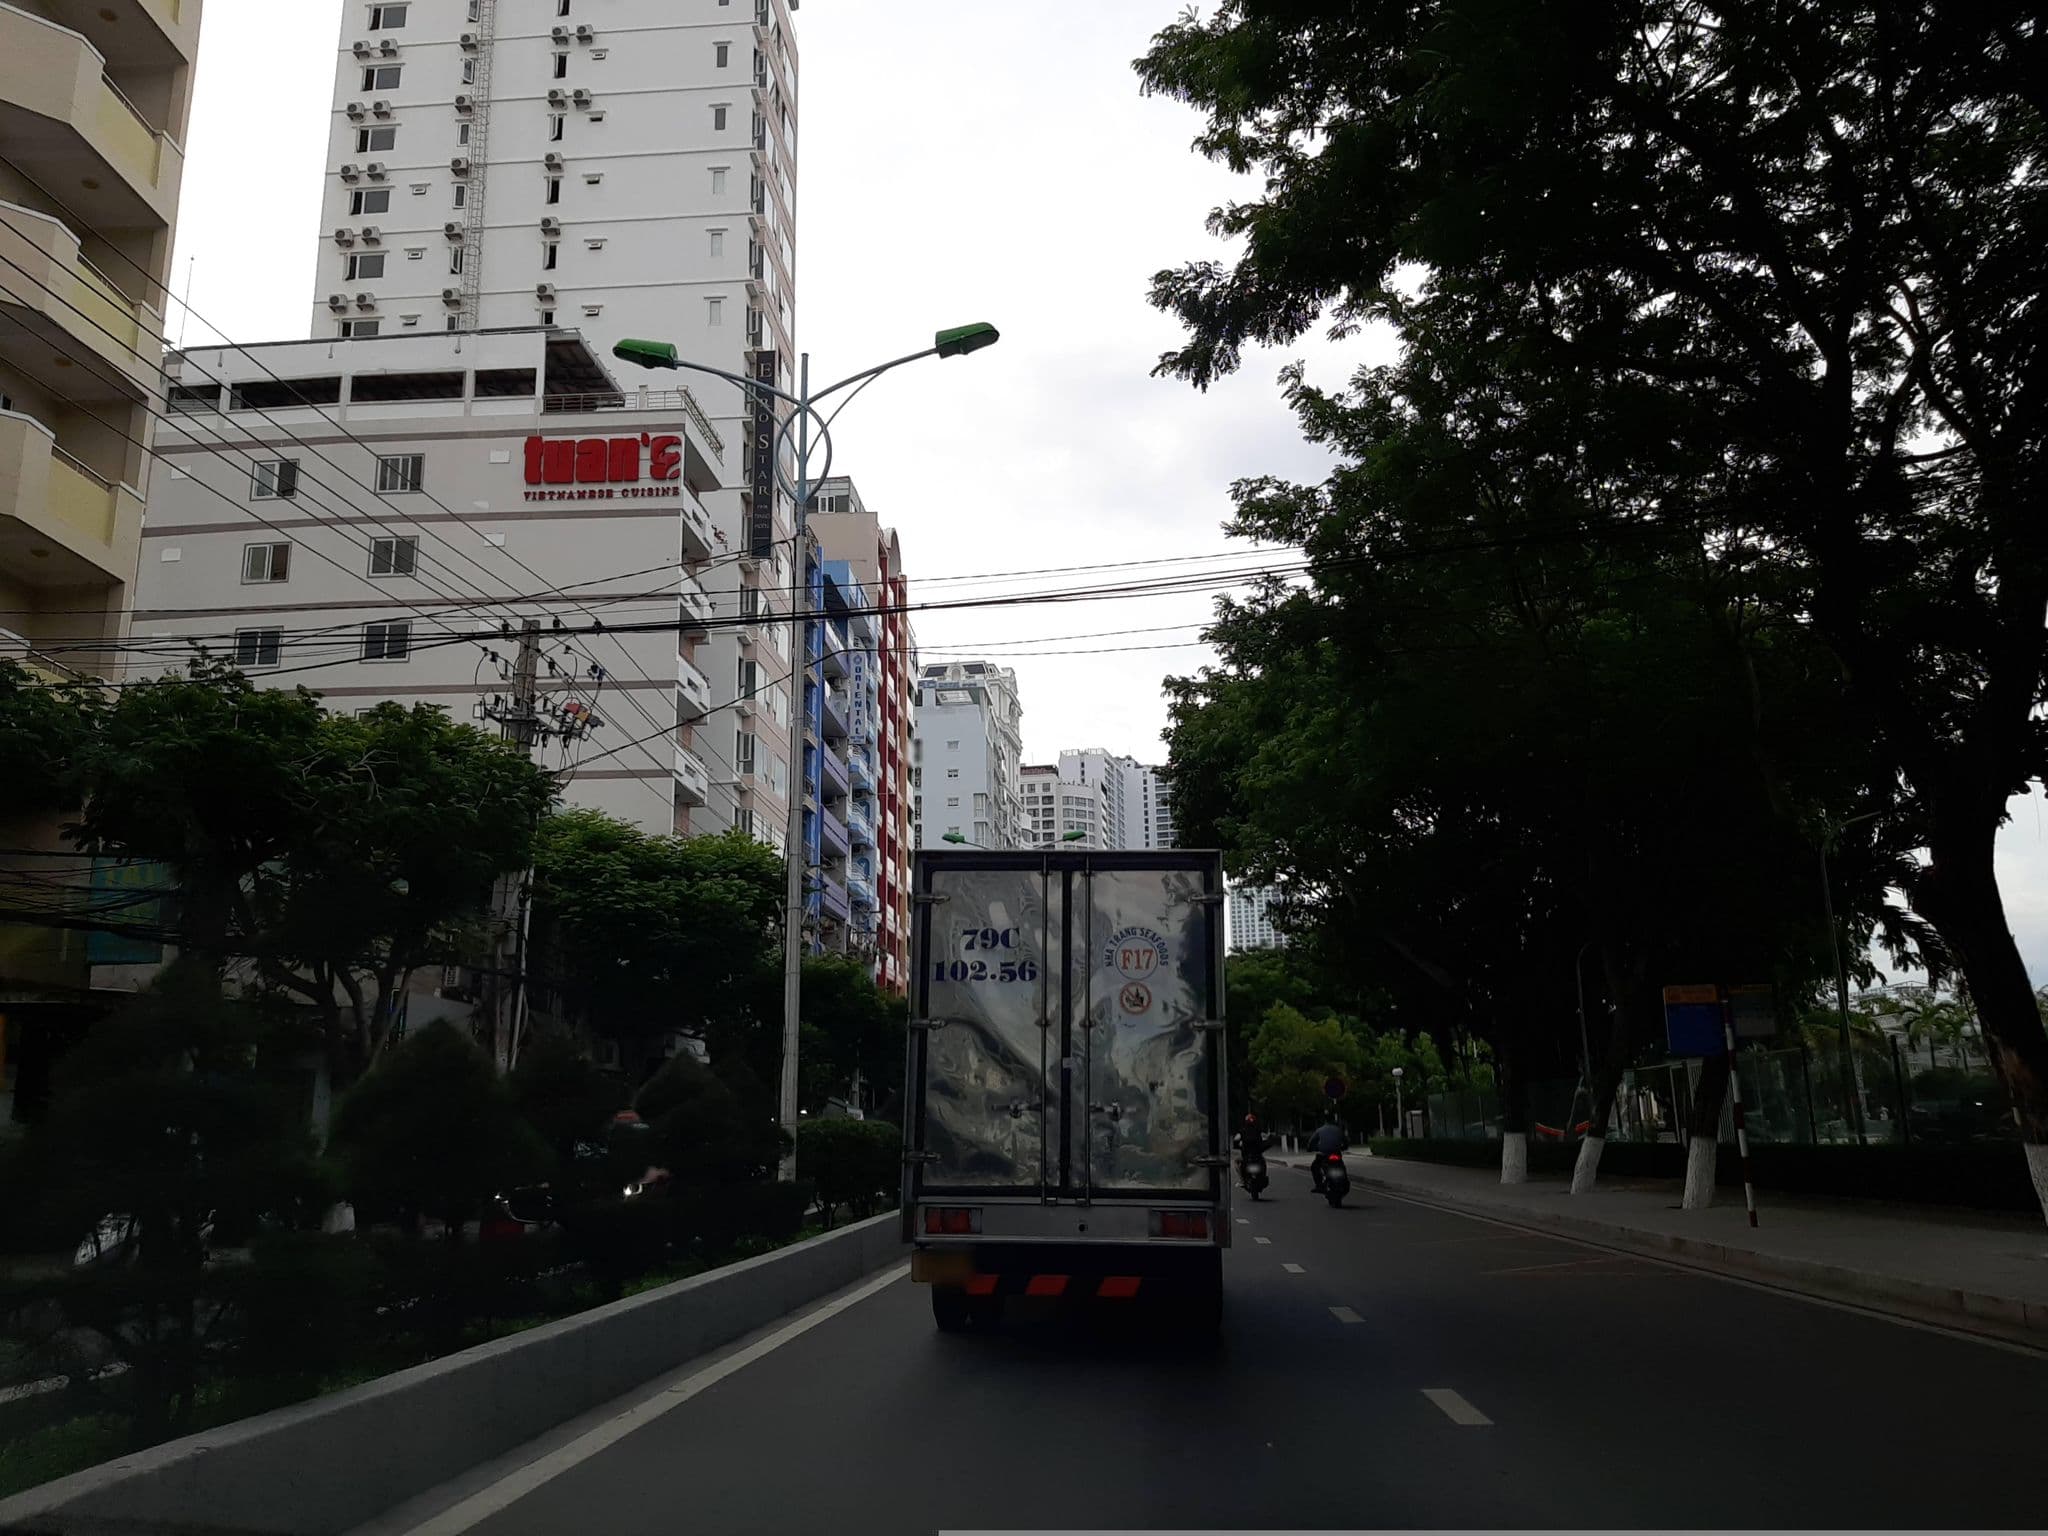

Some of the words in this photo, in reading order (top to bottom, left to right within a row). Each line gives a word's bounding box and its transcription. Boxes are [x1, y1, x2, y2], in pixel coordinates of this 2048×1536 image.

[524, 489, 614, 501] VIETNAMESE
[621, 487, 680, 498] CUISINE
[854, 665, 863, 735] ORIENTAL
[961, 927, 1020, 951] 79C
[1109, 927, 1137, 947] TRANG
[1140, 927, 1168, 966] SEAFOODS
[1104, 948, 1115, 967] NHA
[1120, 949, 1154, 970] F17
[934, 959, 1038, 983] 102.56
